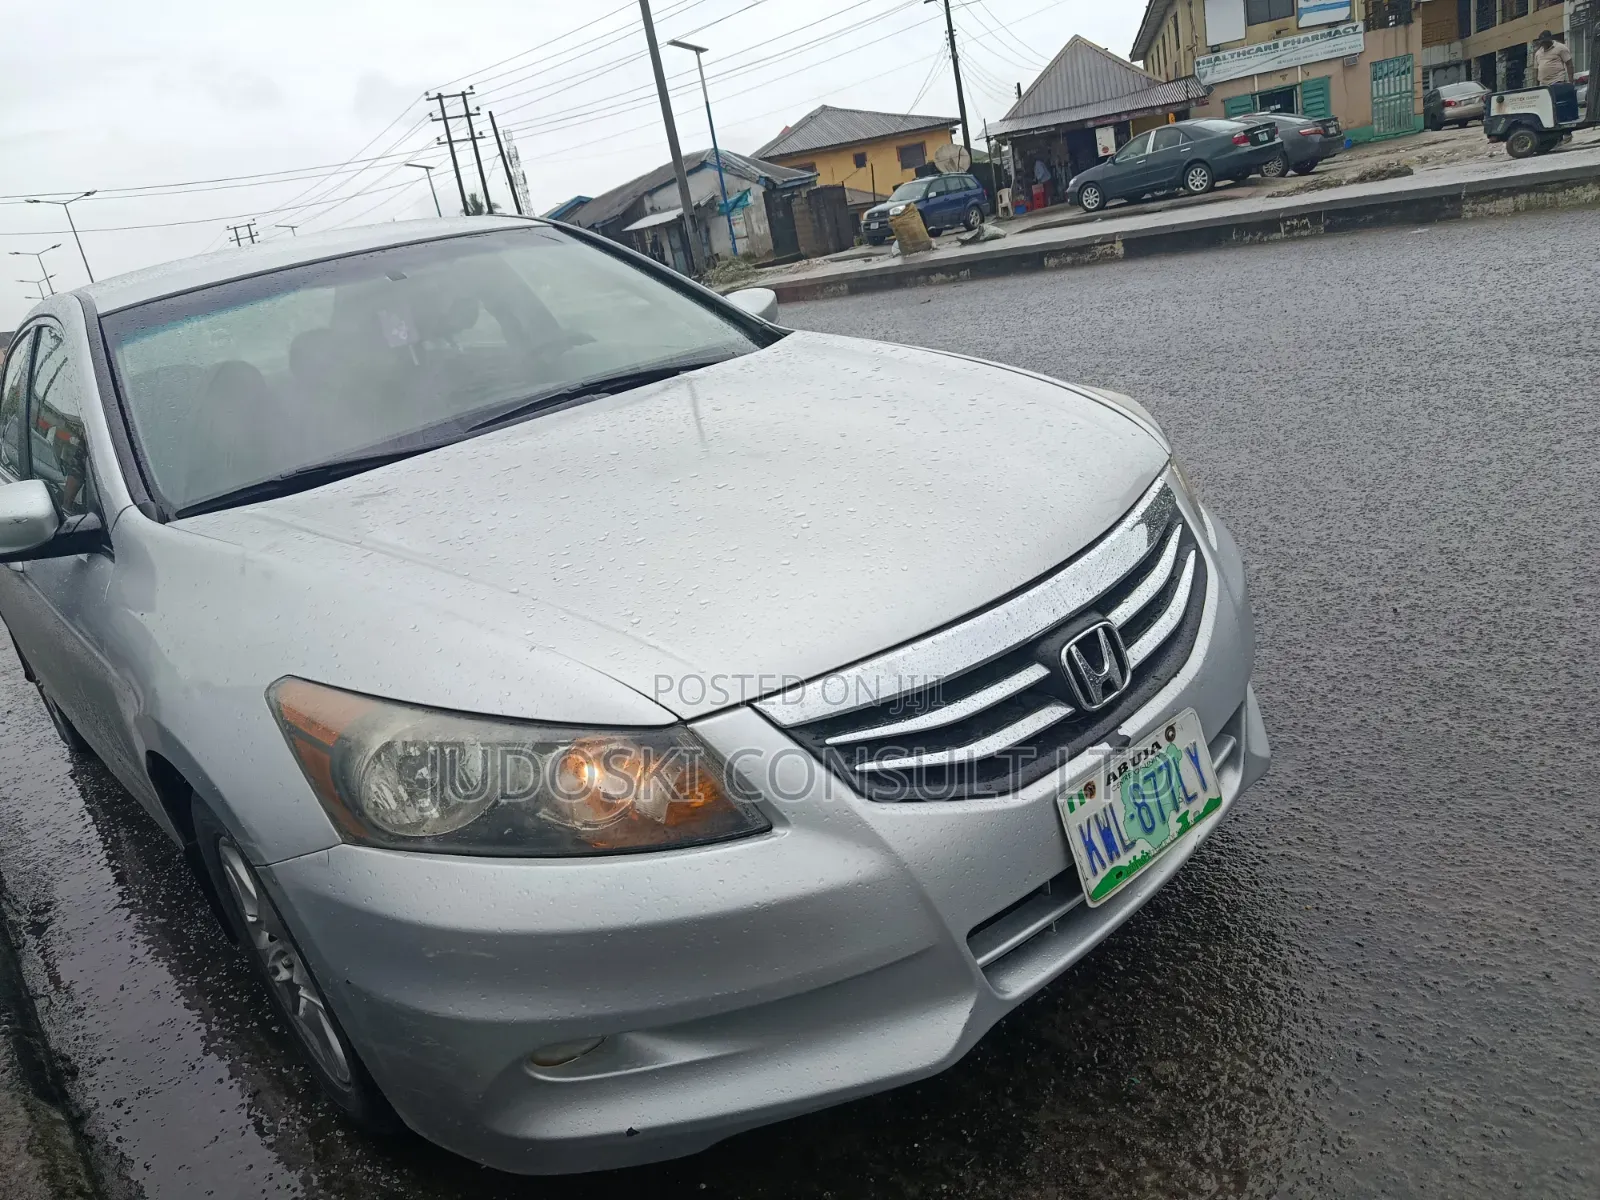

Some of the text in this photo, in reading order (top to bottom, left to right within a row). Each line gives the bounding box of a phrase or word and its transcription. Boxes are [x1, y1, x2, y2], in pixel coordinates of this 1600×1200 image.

[1196, 41, 1280, 67] HEALTHCARE
[1282, 25, 1360, 48] PHARMACY
[1106, 741, 1162, 786] ABUJA
